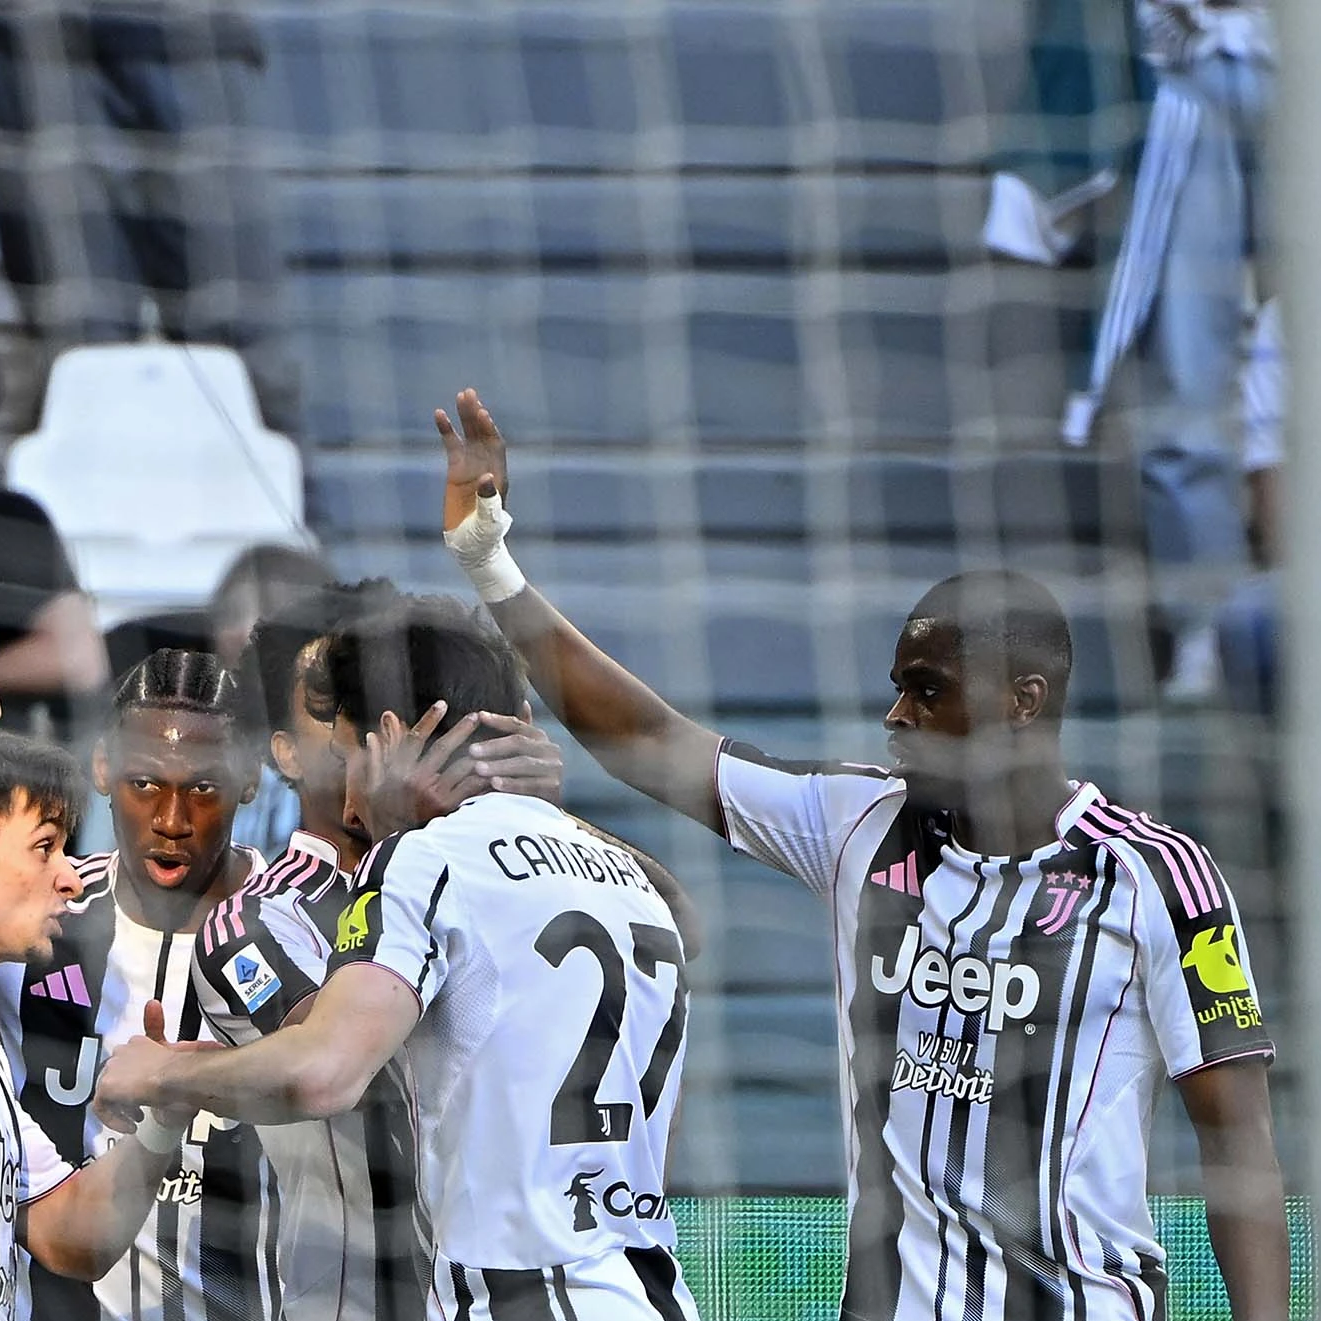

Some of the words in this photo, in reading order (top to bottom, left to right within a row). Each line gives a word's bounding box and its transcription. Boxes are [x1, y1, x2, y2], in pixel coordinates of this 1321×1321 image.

[488, 833, 654, 893] CAMBIAS
[871, 924, 1041, 1032] Jeep
[533, 909, 687, 1146] 27
[917, 1033, 975, 1067] VISIT
[892, 1051, 996, 1104] Detroit
